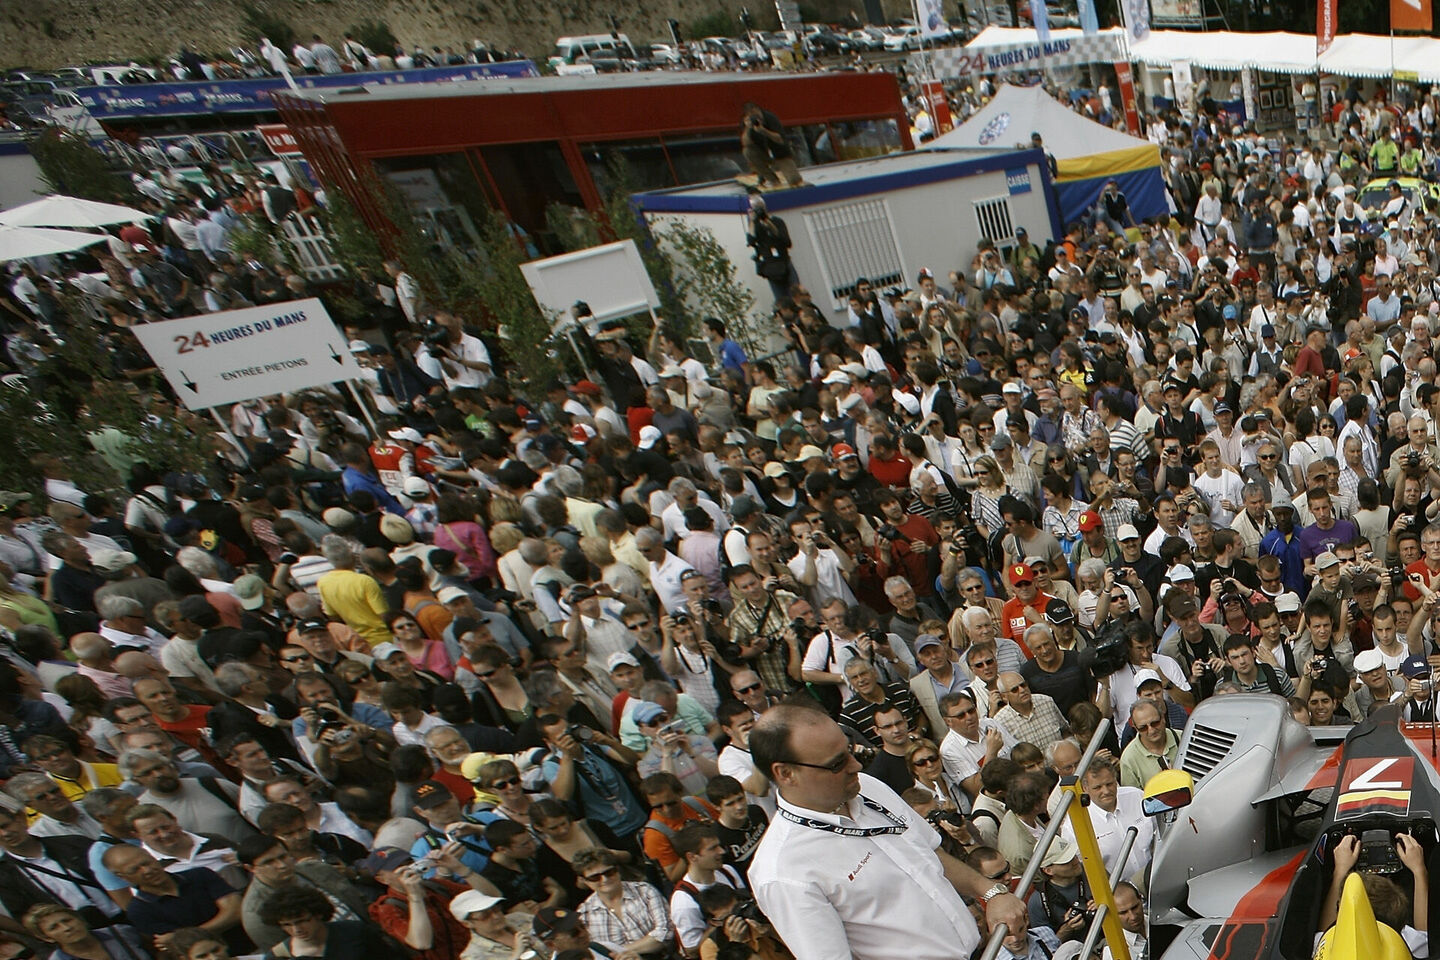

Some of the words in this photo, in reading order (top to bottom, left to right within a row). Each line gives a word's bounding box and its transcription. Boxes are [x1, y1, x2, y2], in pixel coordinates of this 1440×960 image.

[959, 52, 988, 76] 24
[988, 49, 1025, 70] HEURES
[1027, 46, 1040, 60] DU
[1043, 39, 1071, 57] MANS
[1007, 174, 1030, 187] CAISSE
[173, 330, 211, 354] 24
[210, 324, 254, 344] HEURES
[255, 319, 272, 333] DU
[273, 311, 307, 328] MANS
[220, 365, 264, 381] ENTRÉE
[265, 357, 308, 374] PIETONS
[1349, 758, 1403, 789] 7
[843, 829, 865, 837] MANS
